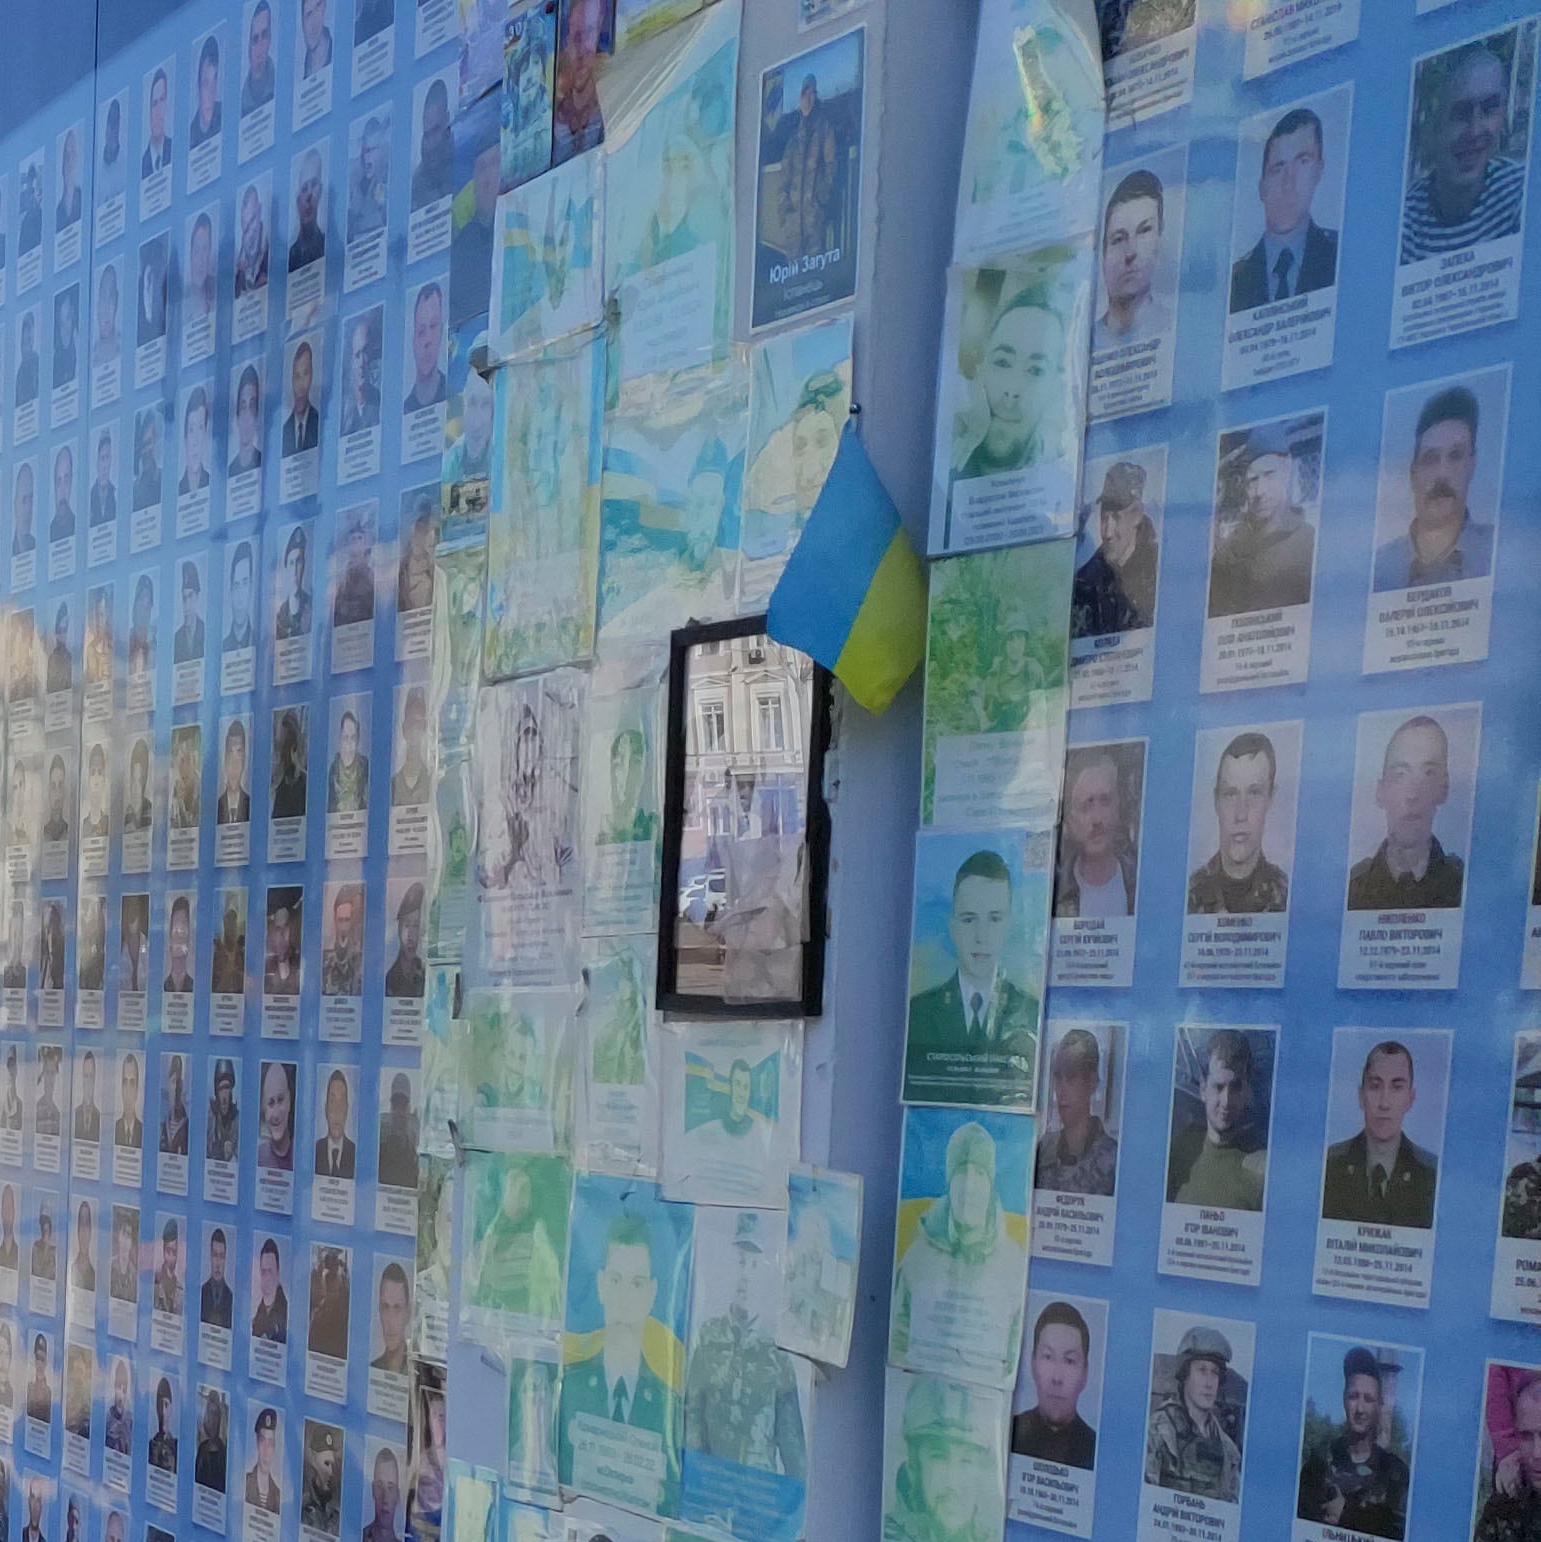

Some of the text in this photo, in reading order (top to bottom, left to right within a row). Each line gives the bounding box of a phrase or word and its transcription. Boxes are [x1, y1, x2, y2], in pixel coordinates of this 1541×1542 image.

[769, 248, 841, 284] Юрій Загута
[1358, 928, 1442, 940] ПАВЛО ВІКТОРОВИЧ
[1152, 1501, 1225, 1529] АНДРІЙ ВІКТОРОВИЧ
